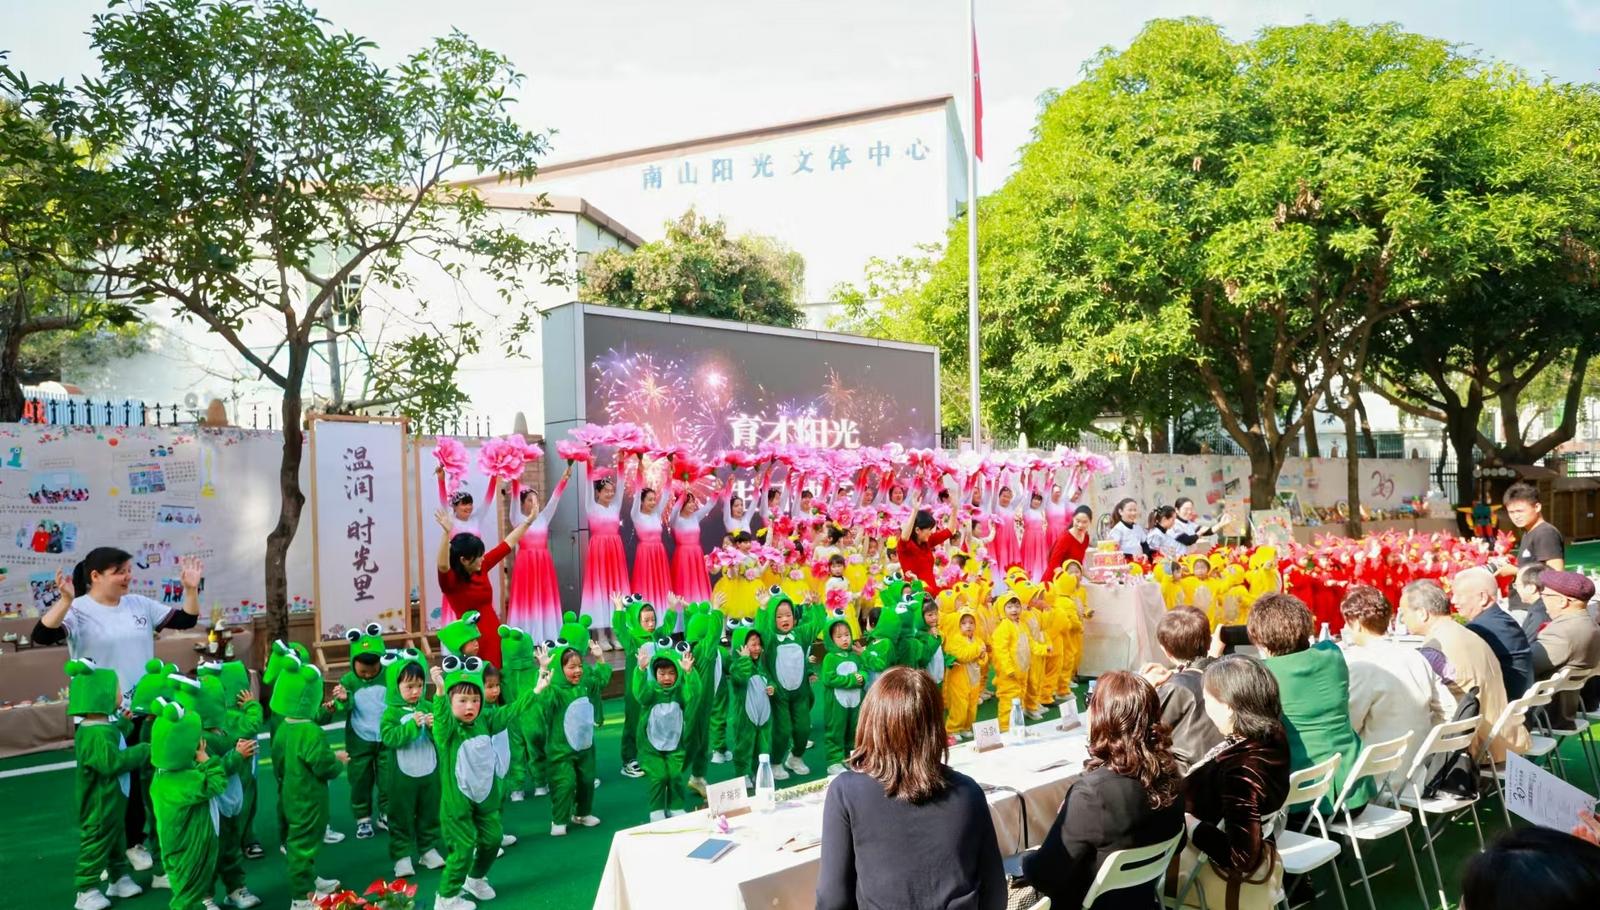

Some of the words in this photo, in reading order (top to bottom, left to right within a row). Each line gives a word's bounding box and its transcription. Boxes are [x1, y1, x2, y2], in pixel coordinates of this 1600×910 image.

[641, 138, 930, 190] 南山阳光文体中心
[727, 413, 861, 450] 育才阳光
